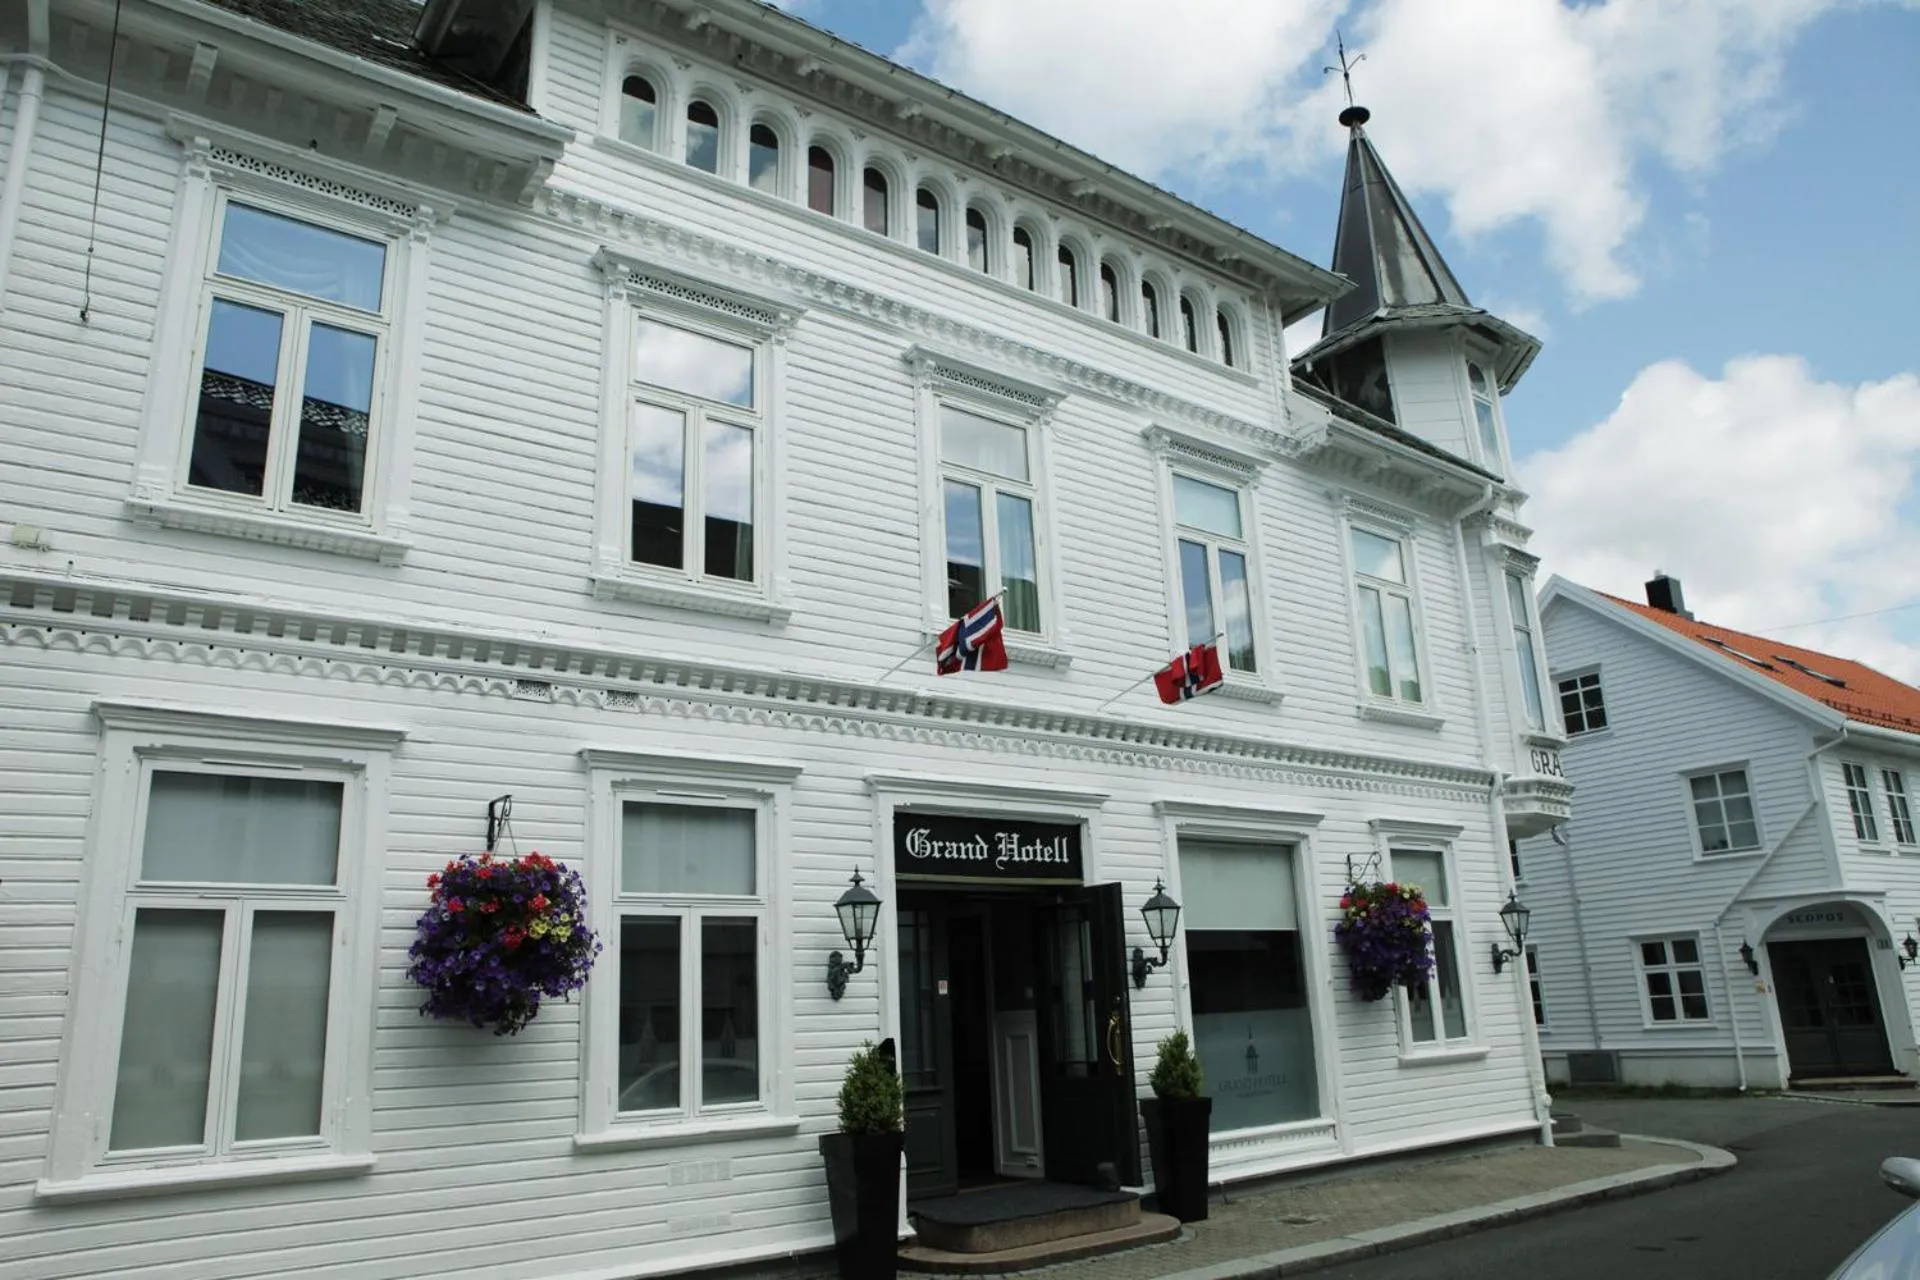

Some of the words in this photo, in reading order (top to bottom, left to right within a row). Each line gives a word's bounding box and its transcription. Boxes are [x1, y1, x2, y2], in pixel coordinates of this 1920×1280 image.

[1530, 749, 1564, 778] GRA
[906, 827, 988, 860] Grand
[995, 832, 1069, 869] Hotell
[1787, 912, 1844, 924] SCOPOS
